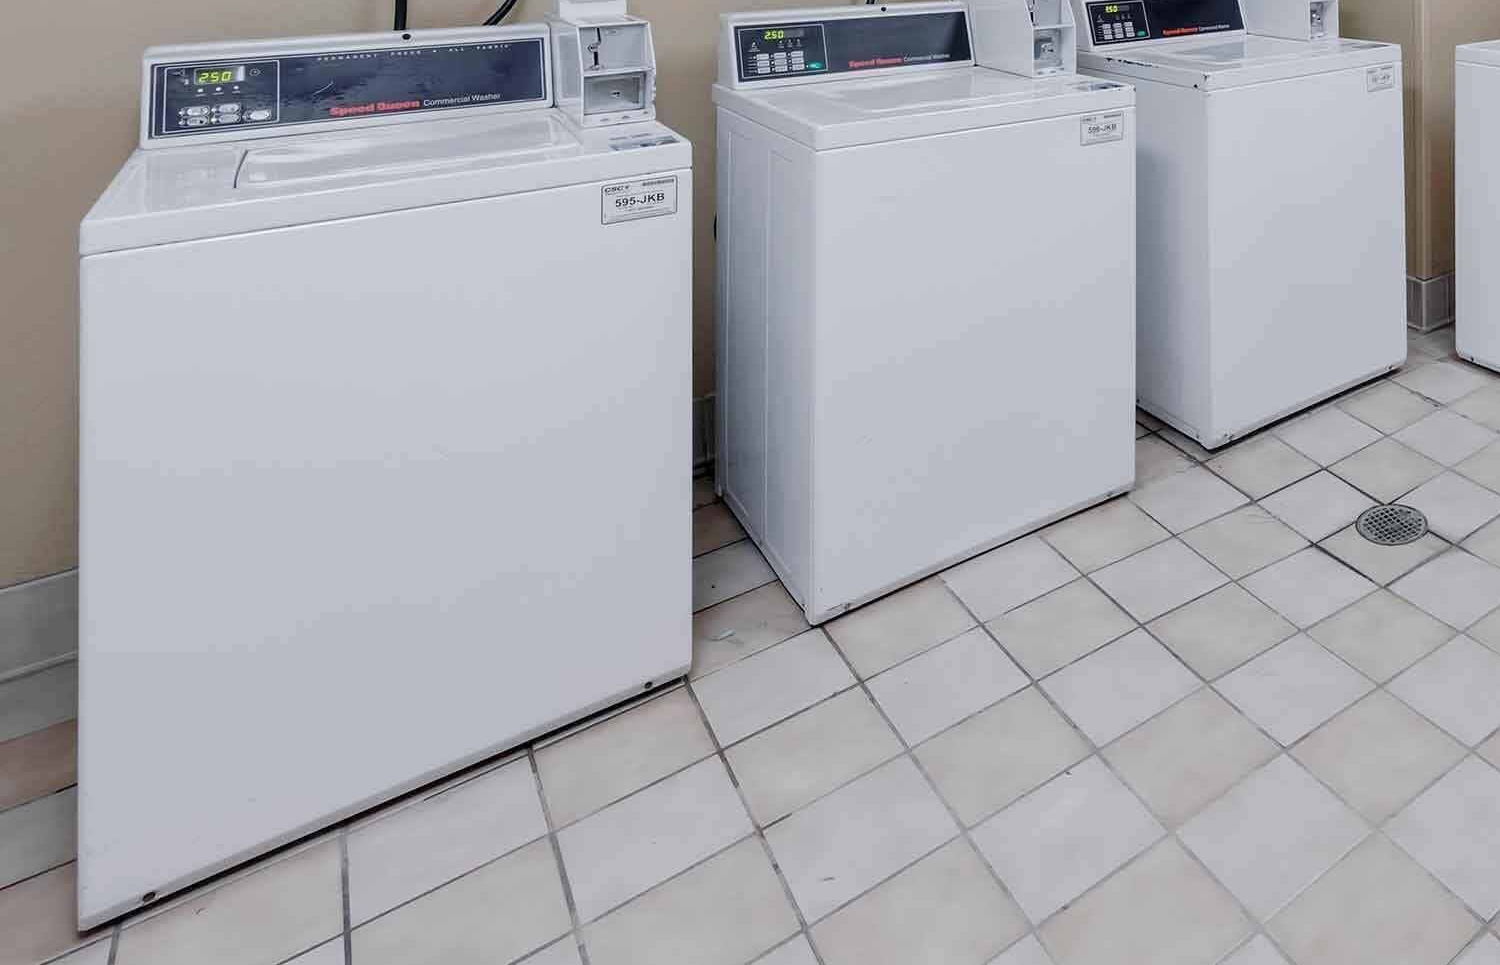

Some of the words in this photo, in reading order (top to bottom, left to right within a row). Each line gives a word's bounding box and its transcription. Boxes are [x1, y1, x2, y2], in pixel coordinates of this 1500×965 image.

[764, 29, 785, 41] 250
[198, 71, 233, 84] 250
[329, 103, 375, 117] Speed
[376, 100, 421, 112] Queen
[615, 192, 666, 208] 595-JKB
